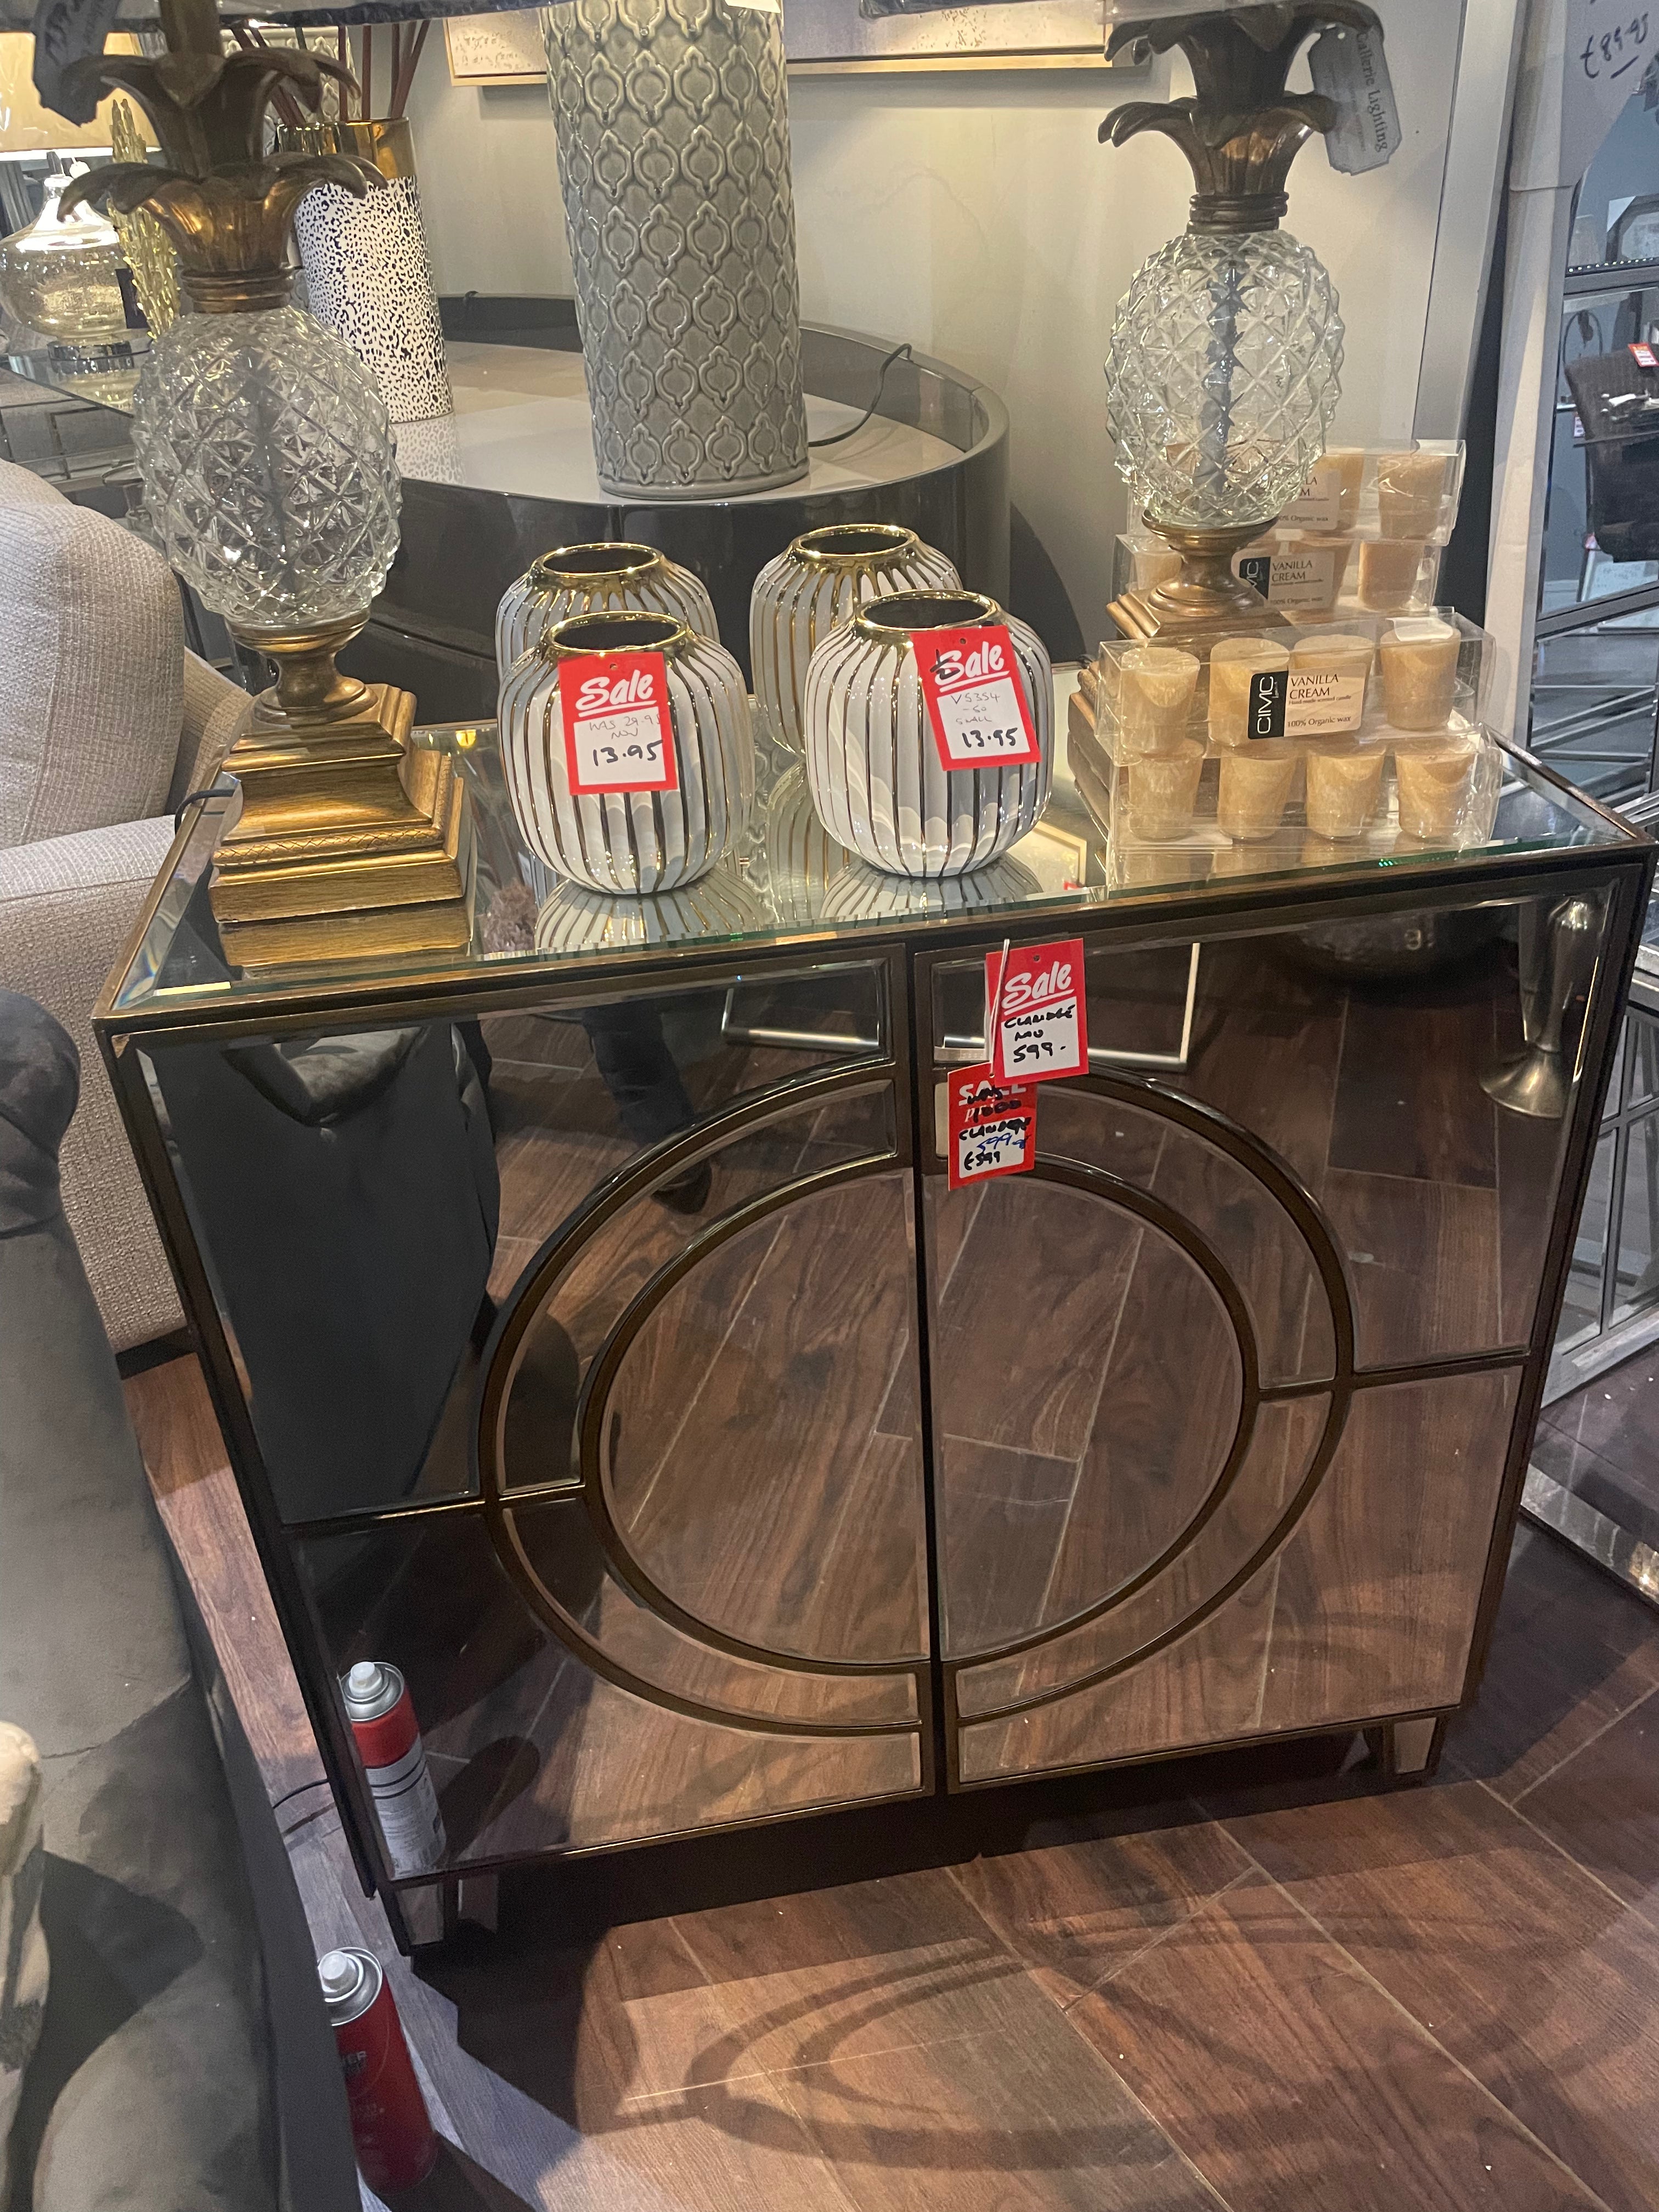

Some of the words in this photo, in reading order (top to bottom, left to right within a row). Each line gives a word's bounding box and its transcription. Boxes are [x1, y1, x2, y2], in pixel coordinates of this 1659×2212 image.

[1367, 89, 1389, 153] Lighting
[1272, 560, 1312, 571] VANILLA
[1272, 571, 1306, 582] CREAM
[935, 641, 1004, 685] Sale
[575, 669, 653, 710] Sale
[1291, 674, 1339, 686] VANILLA
[1257, 676, 1274, 734] CIMC
[1290, 687, 1330, 699] CREAM
[1288, 718, 1306, 727] 100%
[1308, 716, 1335, 726] Organic
[962, 727, 1018, 748] 13.95
[593, 740, 663, 767] 13.95
[1001, 961, 1071, 1009] Sale
